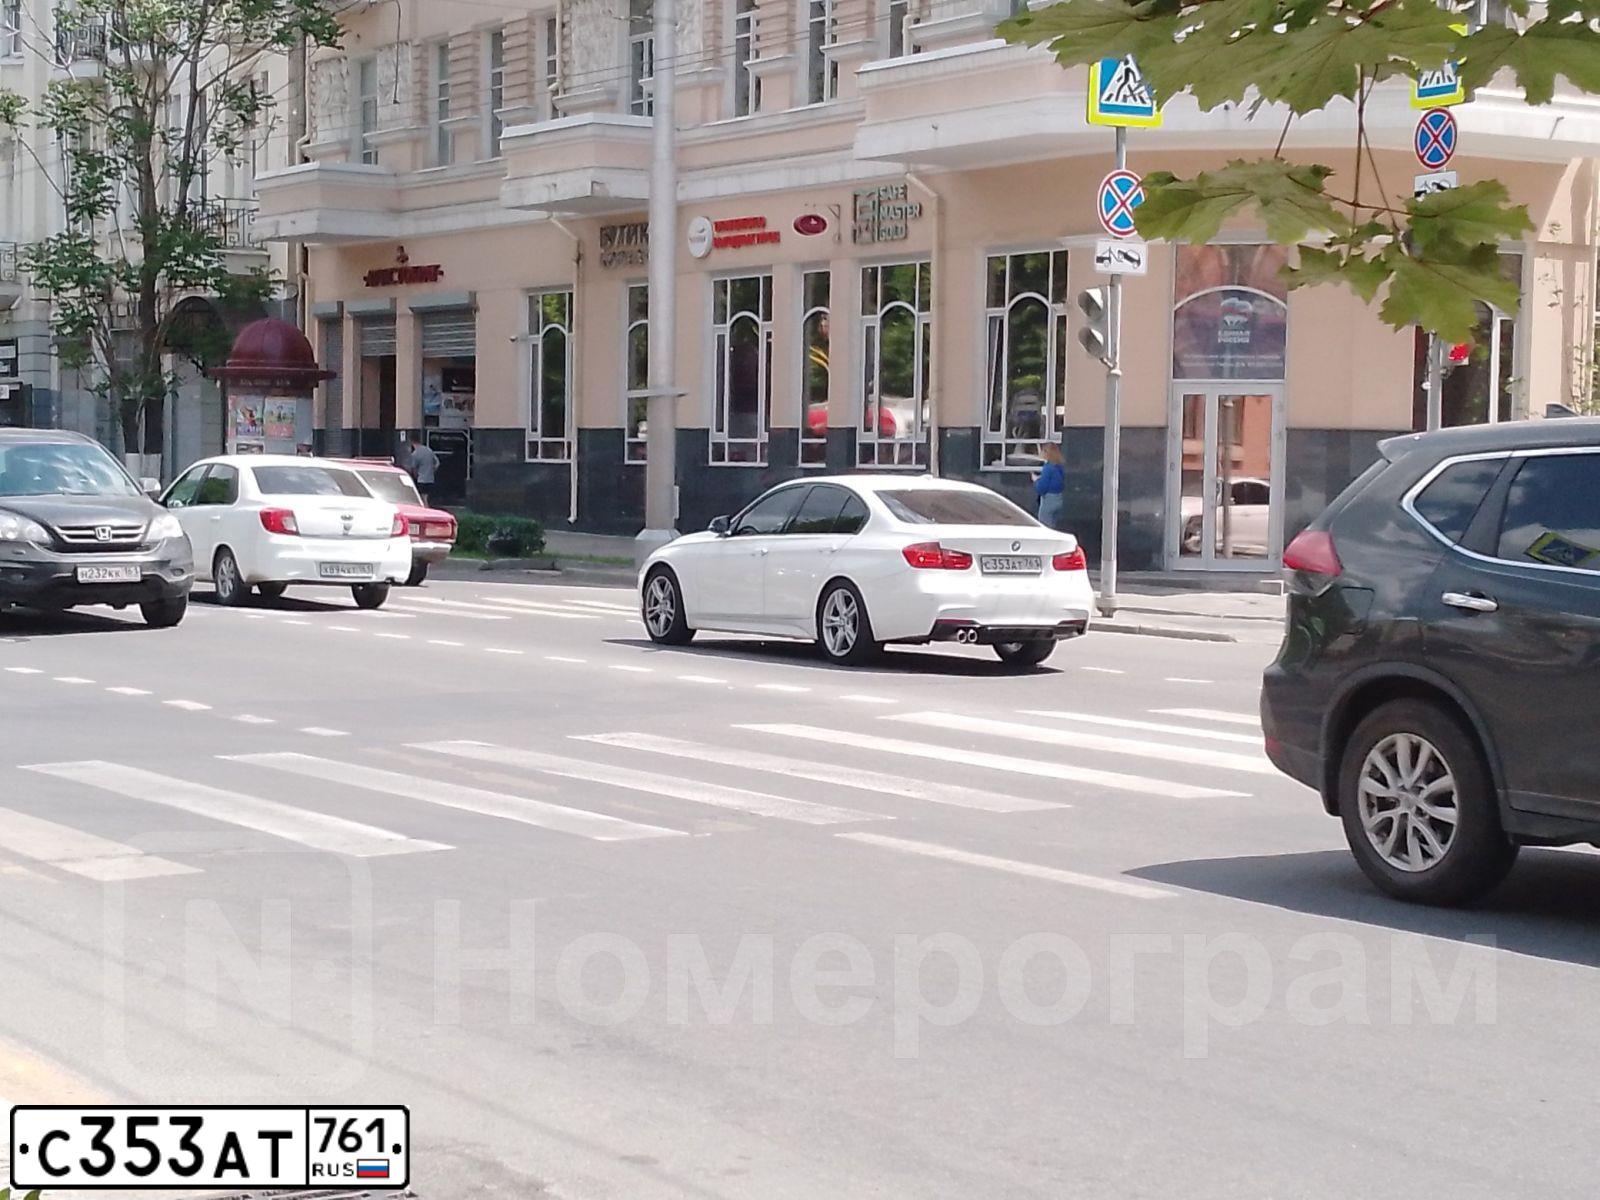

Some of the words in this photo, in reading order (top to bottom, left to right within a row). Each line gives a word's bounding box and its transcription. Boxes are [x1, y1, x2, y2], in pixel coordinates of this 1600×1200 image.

[880, 184, 908, 201] SAFE
[880, 202, 922, 220] MASTER
[880, 222, 907, 240] GOLD
